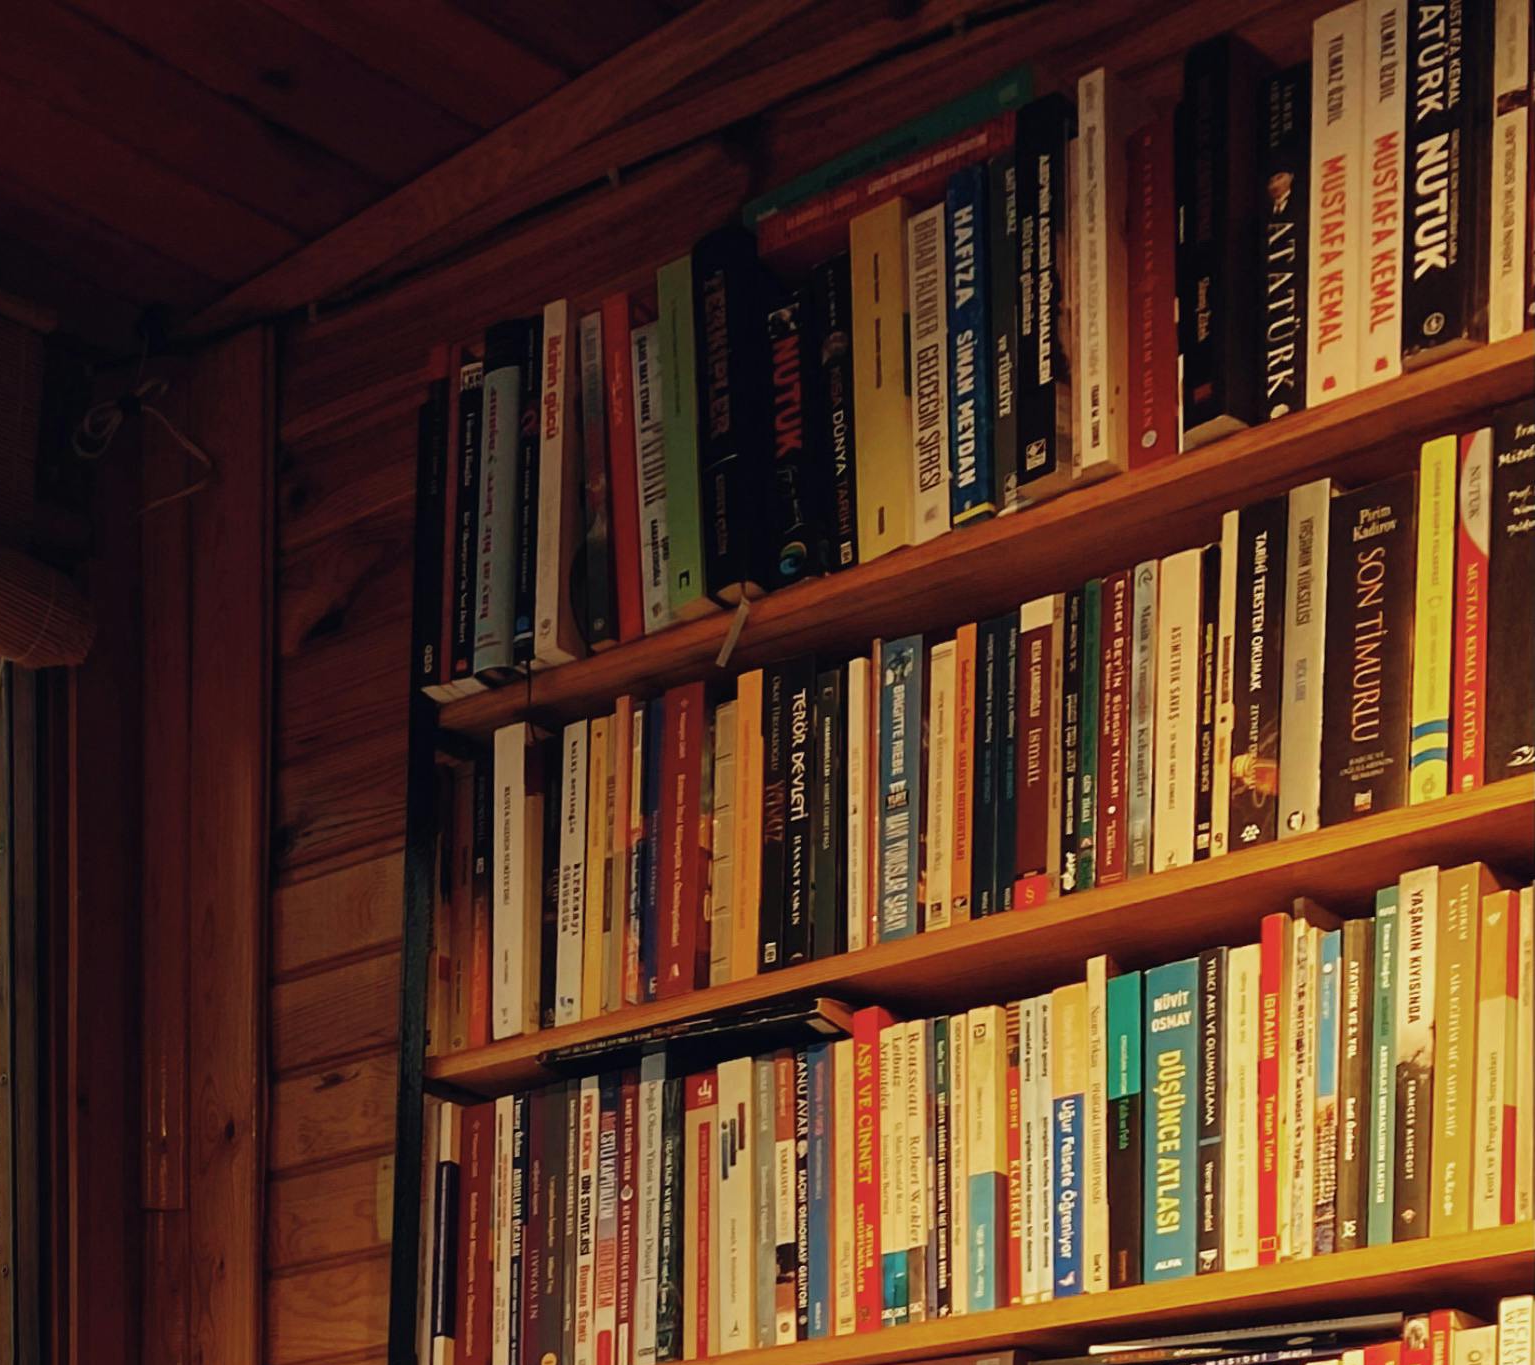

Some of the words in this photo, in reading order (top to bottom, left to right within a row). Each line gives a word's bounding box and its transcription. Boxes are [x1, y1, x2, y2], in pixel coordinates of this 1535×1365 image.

[1328, 36, 1345, 81] YILMAZ
[1379, 9, 1398, 60] YILMAZ
[1326, 85, 1346, 126] ÖZDİL
[1379, 63, 1397, 104] ÖZDİL
[1320, 155, 1348, 266] MUSTAFA
[1373, 132, 1400, 247] MUSTAFA
[1414, 132, 1449, 281] NUTUK
[953, 205, 975, 310] HAFIZA
[1265, 218, 1296, 399] ATATÜRK
[1318, 270, 1347, 354] KEMAL
[1370, 251, 1397, 334] KEMAL
[771, 333, 803, 458] NUTUK
[915, 343, 944, 432] GELECEĞİN
[955, 328, 978, 396] SİNAN
[916, 434, 942, 493] ŞİFRESİ
[956, 400, 977, 488] MEYDAN
[1253, 531, 1269, 573] TARİHİ
[1355, 549, 1386, 607] SON
[1252, 576, 1266, 633] TERSTEN
[1465, 563, 1481, 632] MUSTAFA
[1249, 636, 1264, 691] OKUMAK
[1350, 610, 1389, 743] TİMURLU
[1463, 636, 1479, 686] KEMAL
[790, 687, 810, 745] TERÖR
[1462, 689, 1480, 761] ATATÜRK
[789, 751, 810, 822] DEVLETİ
[1407, 890, 1425, 951] YAŞAMIN
[1406, 955, 1424, 1024] KIYISINDA
[856, 1043, 873, 1080] AŞK
[907, 1031, 921, 1118] Rousseau
[858, 1084, 873, 1109] VE
[1057, 1098, 1075, 1133] Uğur
[1152, 1049, 1187, 1153] DÜŞÜNCE
[858, 1114, 876, 1184] CİNNET
[909, 1136, 922, 1185] Robert
[1060, 1136, 1076, 1186] Felsefe
[909, 1189, 922, 1245] Wokler
[1057, 1190, 1079, 1258] Öğreniyor
[1155, 1158, 1181, 1235] ATLASI
